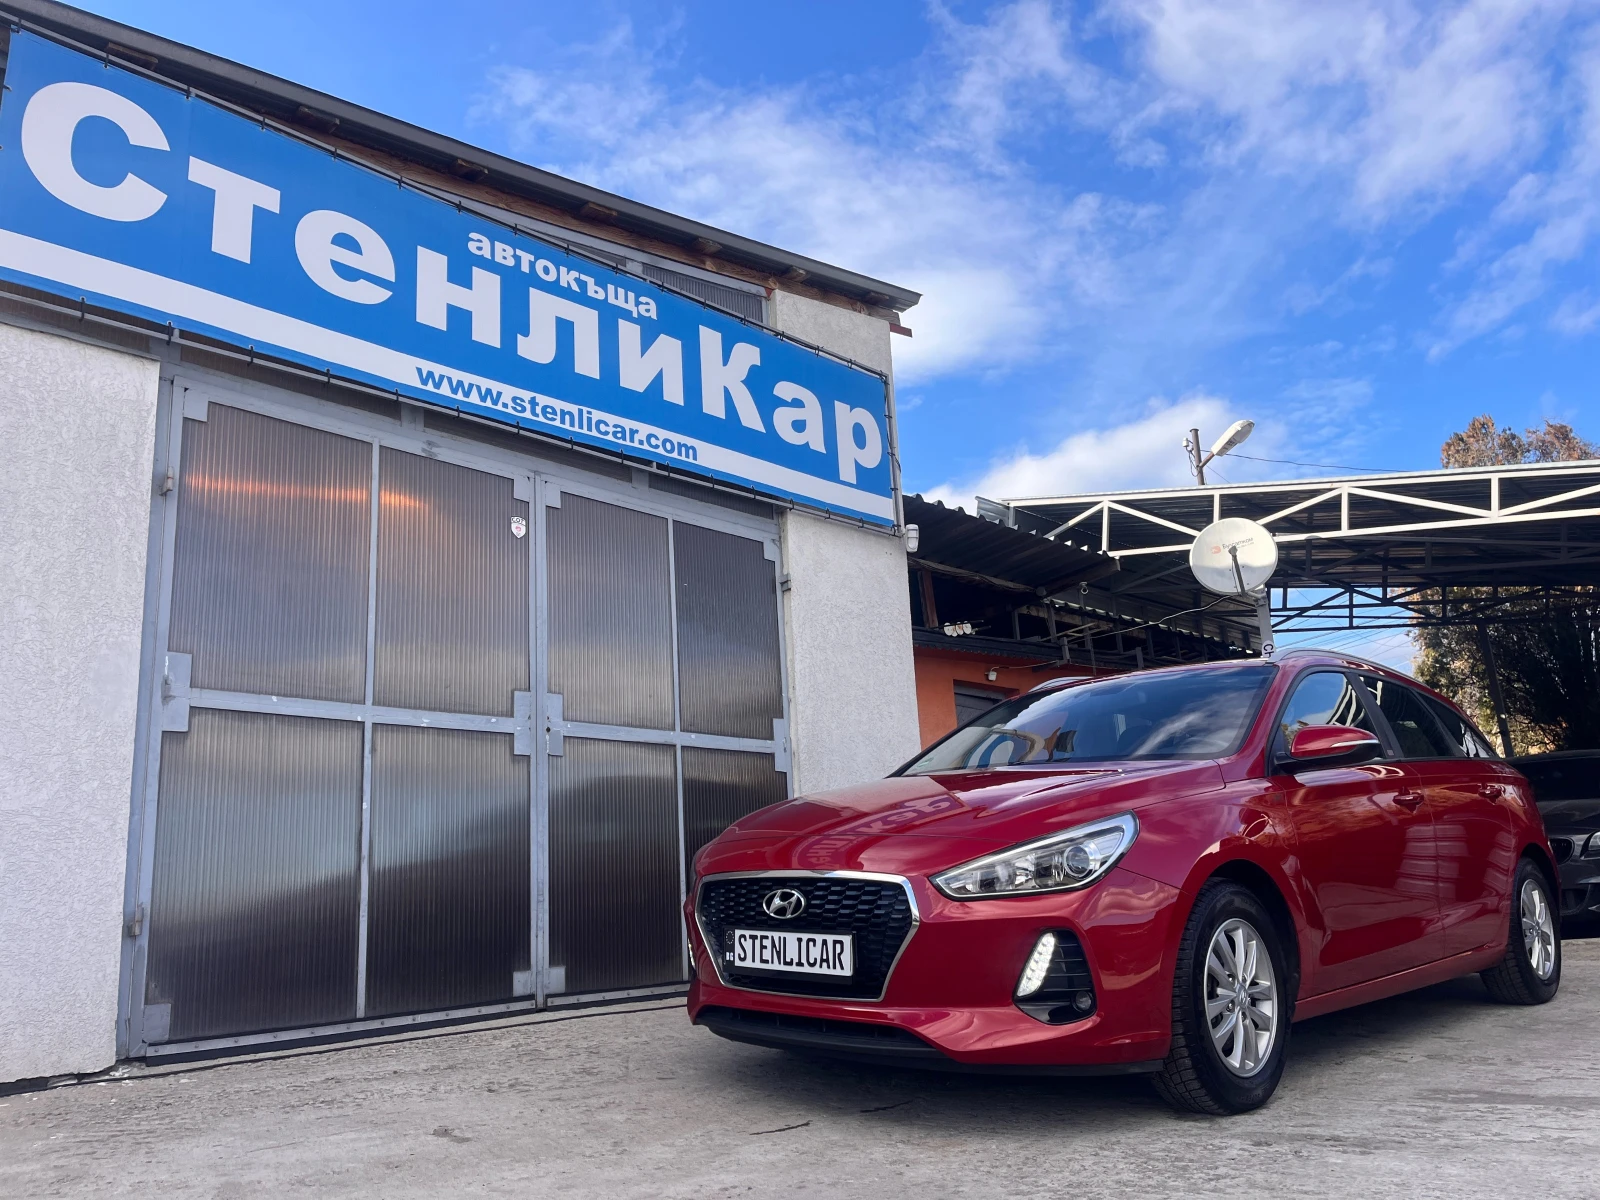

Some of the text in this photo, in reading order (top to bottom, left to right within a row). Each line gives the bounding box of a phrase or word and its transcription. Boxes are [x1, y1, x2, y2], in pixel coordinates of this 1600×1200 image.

[20, 81, 884, 485] СтенлиКар
[467, 231, 658, 320] автокъща
[414, 366, 699, 462] www.stenlicar.com
[738, 933, 845, 970] STENLICAR
